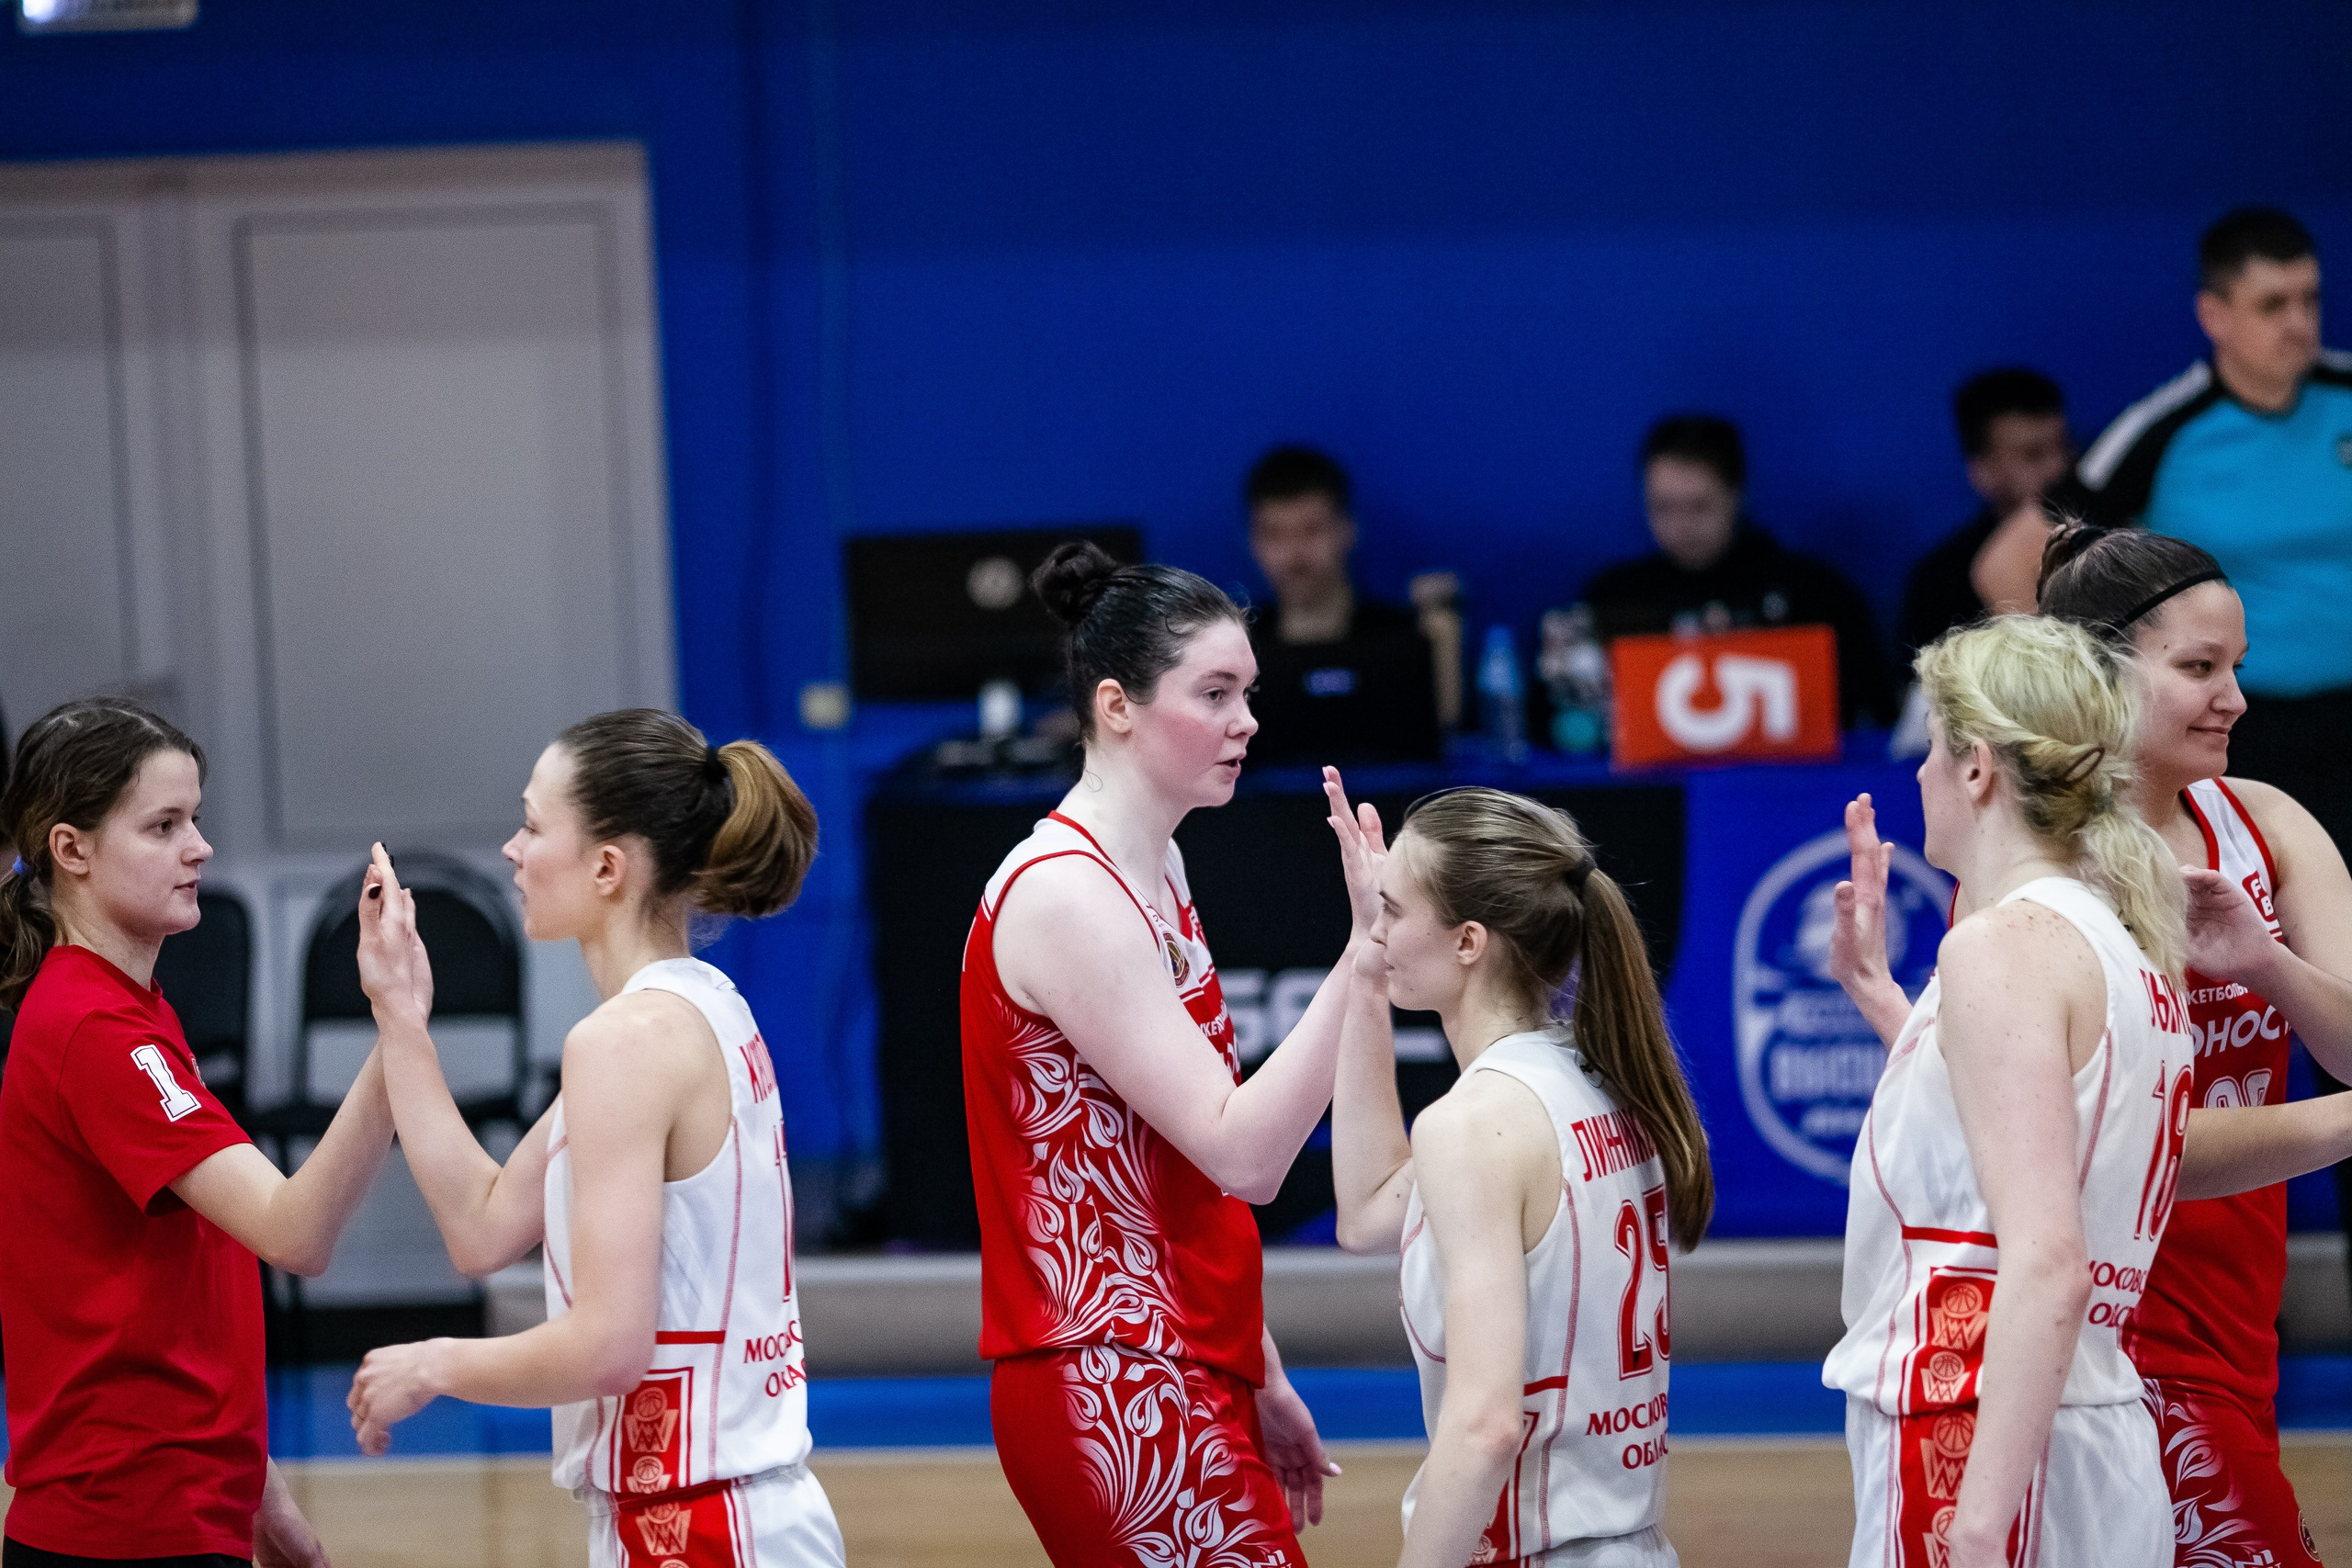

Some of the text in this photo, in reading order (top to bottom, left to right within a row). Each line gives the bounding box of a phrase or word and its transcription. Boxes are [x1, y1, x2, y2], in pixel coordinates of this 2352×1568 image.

[1655, 653, 1797, 750] 5
[130, 1044, 202, 1122] 1
[1614, 1183, 1670, 1382] 25
